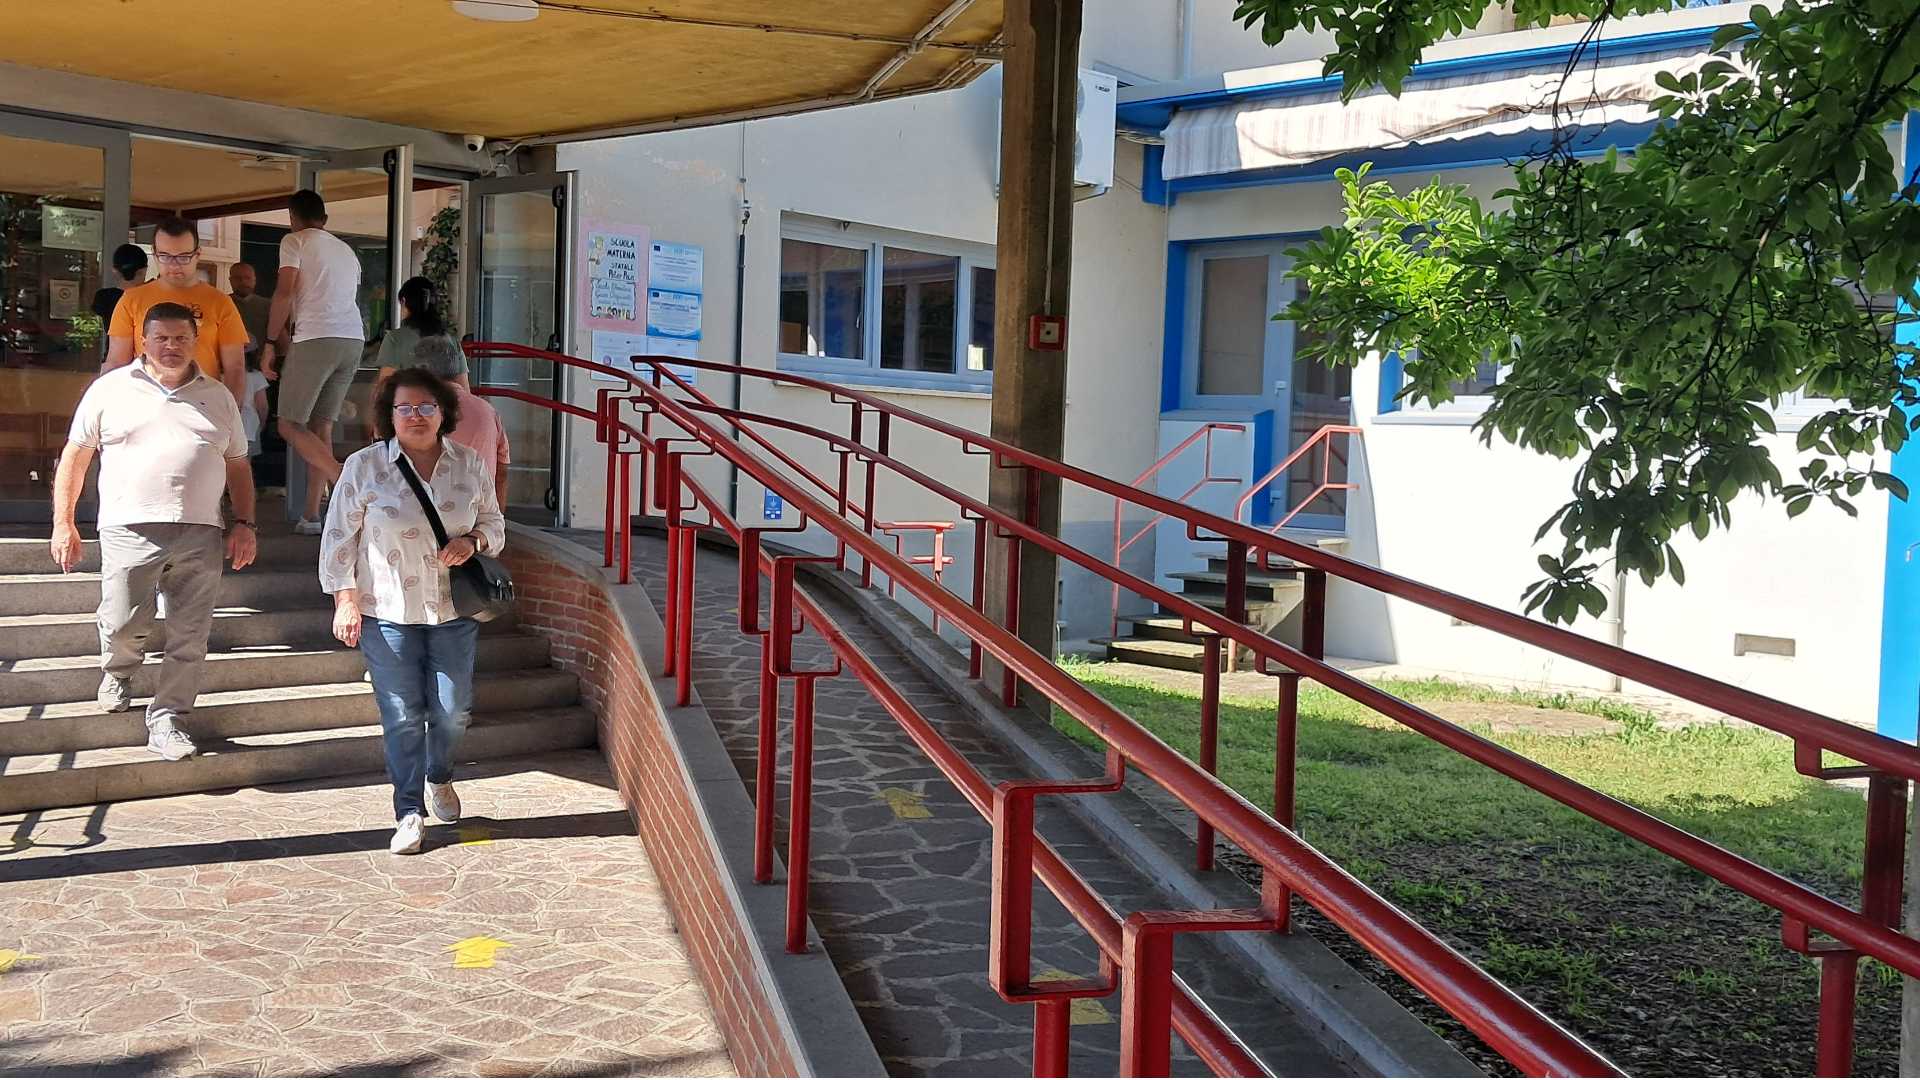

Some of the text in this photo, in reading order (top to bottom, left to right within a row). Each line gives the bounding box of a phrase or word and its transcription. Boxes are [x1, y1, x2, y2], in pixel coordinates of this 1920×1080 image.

[610, 238, 635, 248] SCUOLA
[607, 249, 635, 260] MATERNA
[611, 263, 634, 271] STATALE
